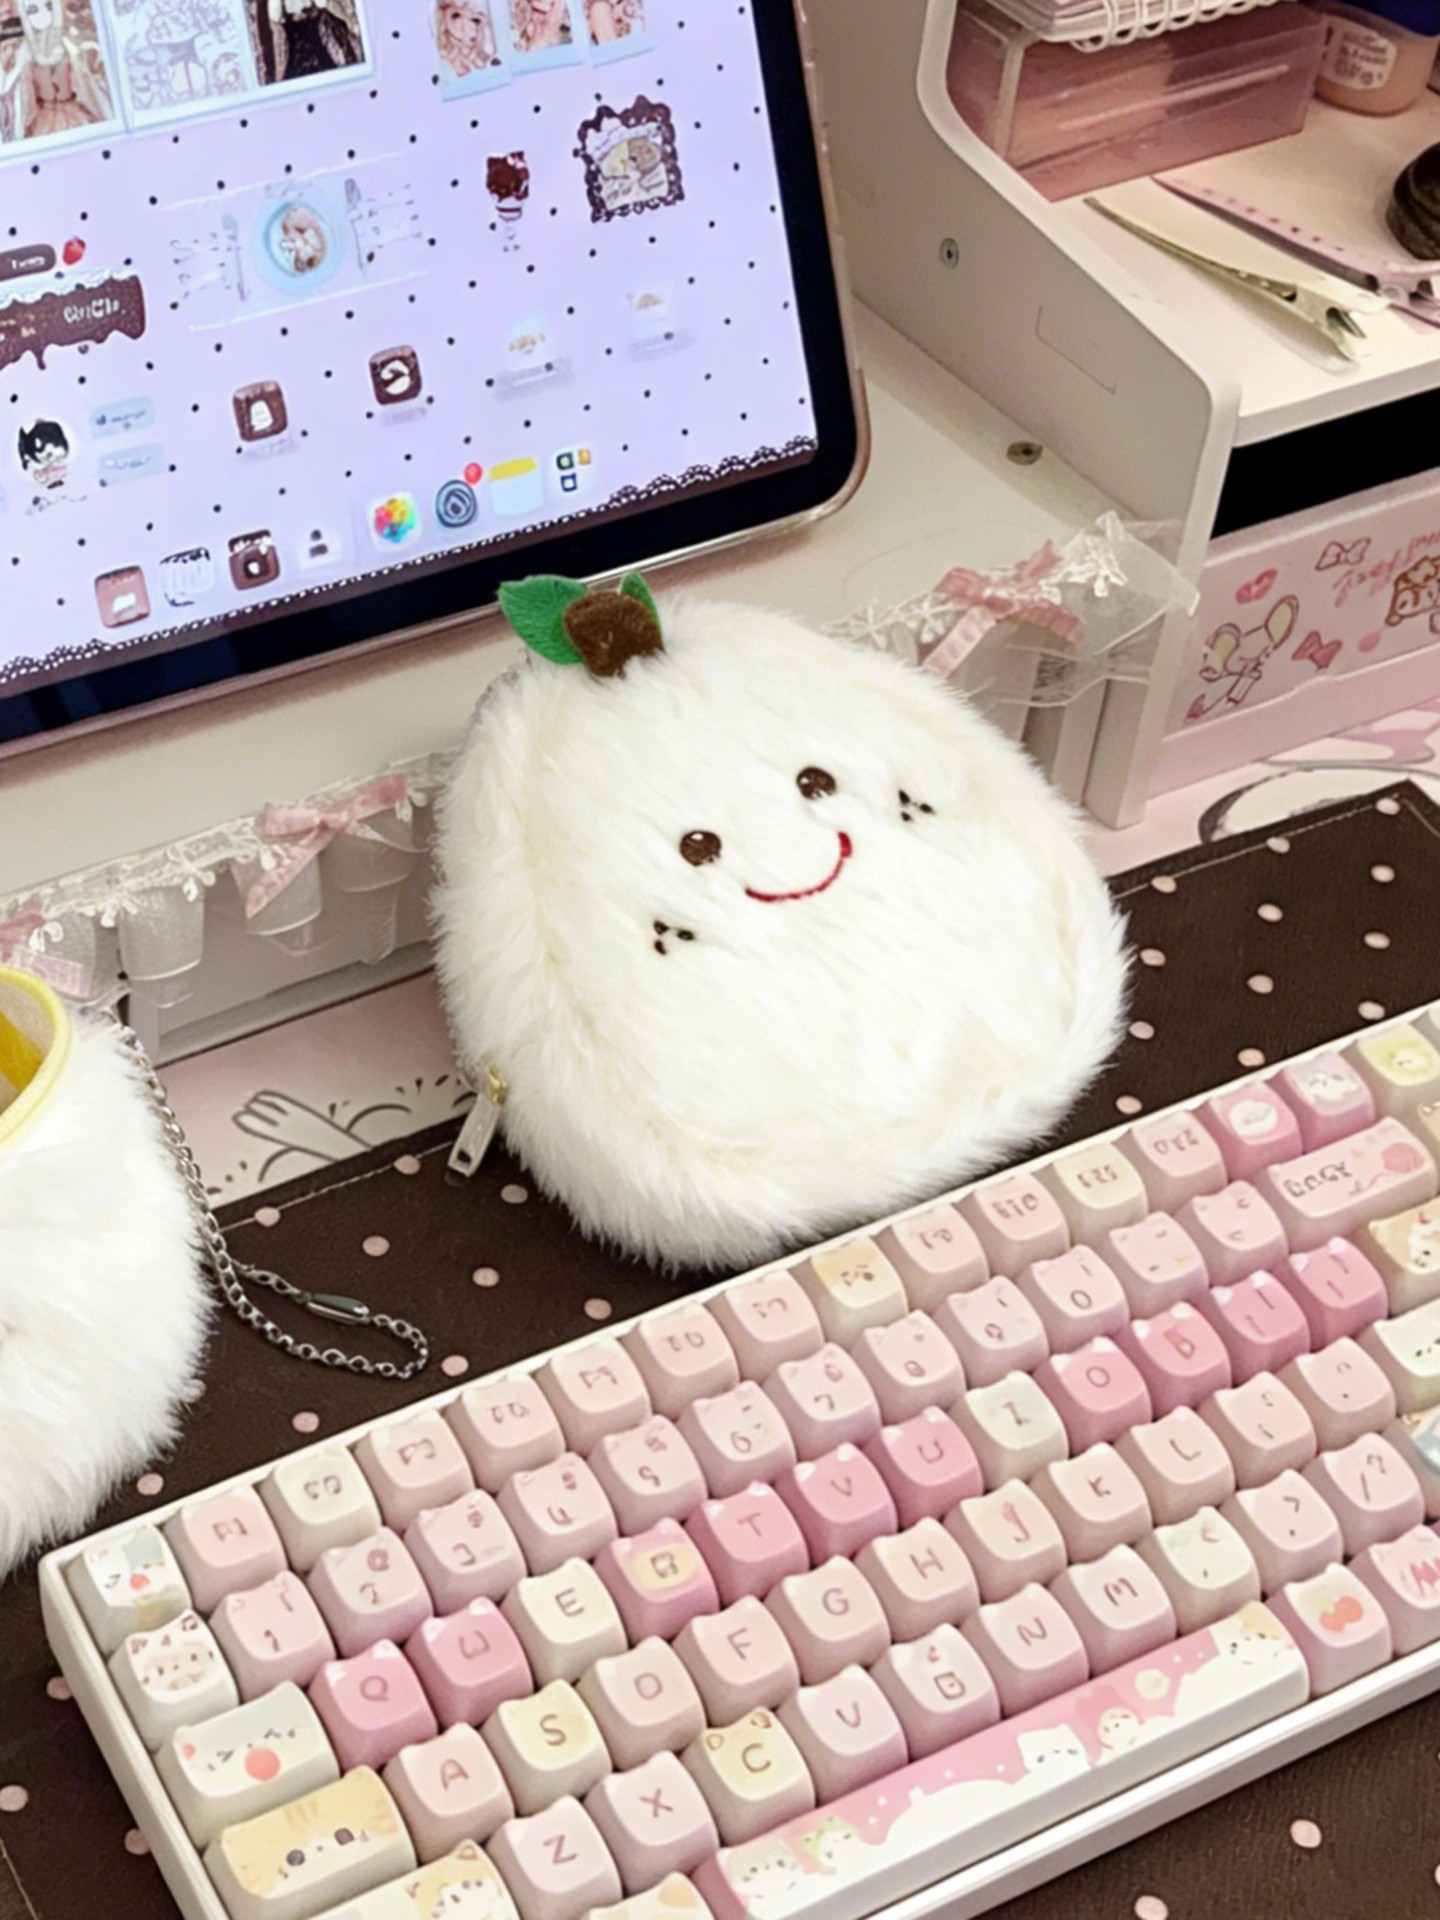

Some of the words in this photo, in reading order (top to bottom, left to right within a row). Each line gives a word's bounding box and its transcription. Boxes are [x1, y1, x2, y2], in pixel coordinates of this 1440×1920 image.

[917, 1440, 944, 1464] U
[737, 1511, 763, 1537] T
[910, 1547, 944, 1579] H
[555, 1588, 585, 1617] E
[822, 1587, 850, 1617] G
[727, 1627, 752, 1660] F
[1017, 1616, 1047, 1646] N
[359, 1675, 390, 1702] Q
[540, 1713, 567, 1747] S
[742, 1742, 772, 1773] C
[439, 1758, 469, 1791] A
[640, 1787, 674, 1818] X
[543, 1834, 578, 1865] Z
